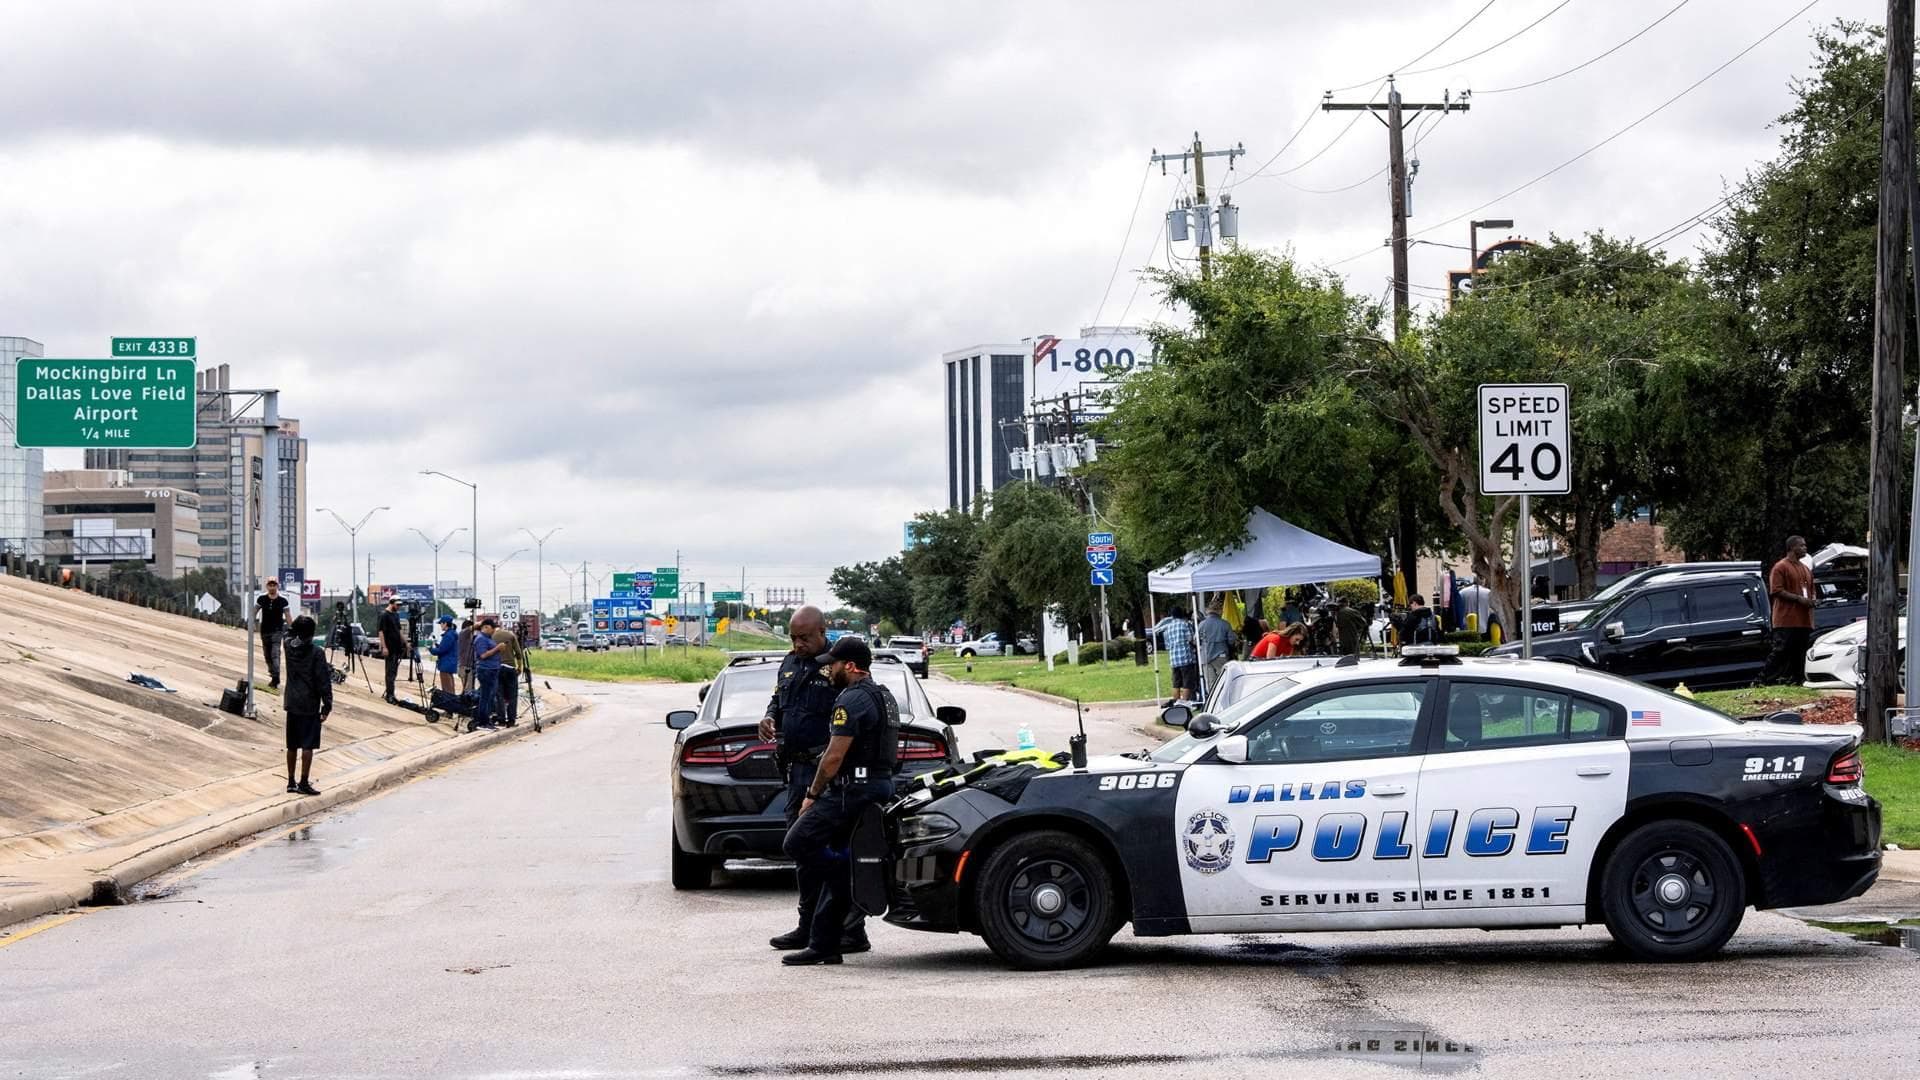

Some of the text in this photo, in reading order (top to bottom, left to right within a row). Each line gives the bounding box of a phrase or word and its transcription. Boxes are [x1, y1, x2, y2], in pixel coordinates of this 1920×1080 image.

[119, 343, 142, 352] EXIT
[36, 366, 176, 383] Mockingbird Ln
[26, 386, 186, 400] Dallas Love Field
[1488, 397, 1560, 414] SPEED
[73, 406, 138, 423] Airport
[105, 429, 130, 438] MILE
[1496, 420, 1552, 437] LIMIT
[1490, 442, 1562, 481] 40
[144, 490, 170, 498] 7610
[1090, 535, 1112, 544] SOUTH
[1091, 552, 1112, 565] 35E
[303, 582, 317, 595] QT
[636, 586, 652, 596] 35E
[502, 611, 517, 620] 60
[1099, 773, 1177, 791] 9096
[1742, 772, 1802, 781] EMERGENCY
[1227, 780, 1367, 803] DALLAS
[1190, 811, 1229, 824] POLICE
[1246, 806, 1577, 864] POLICE
[1261, 887, 1550, 906] SERVING SINCE 1881
